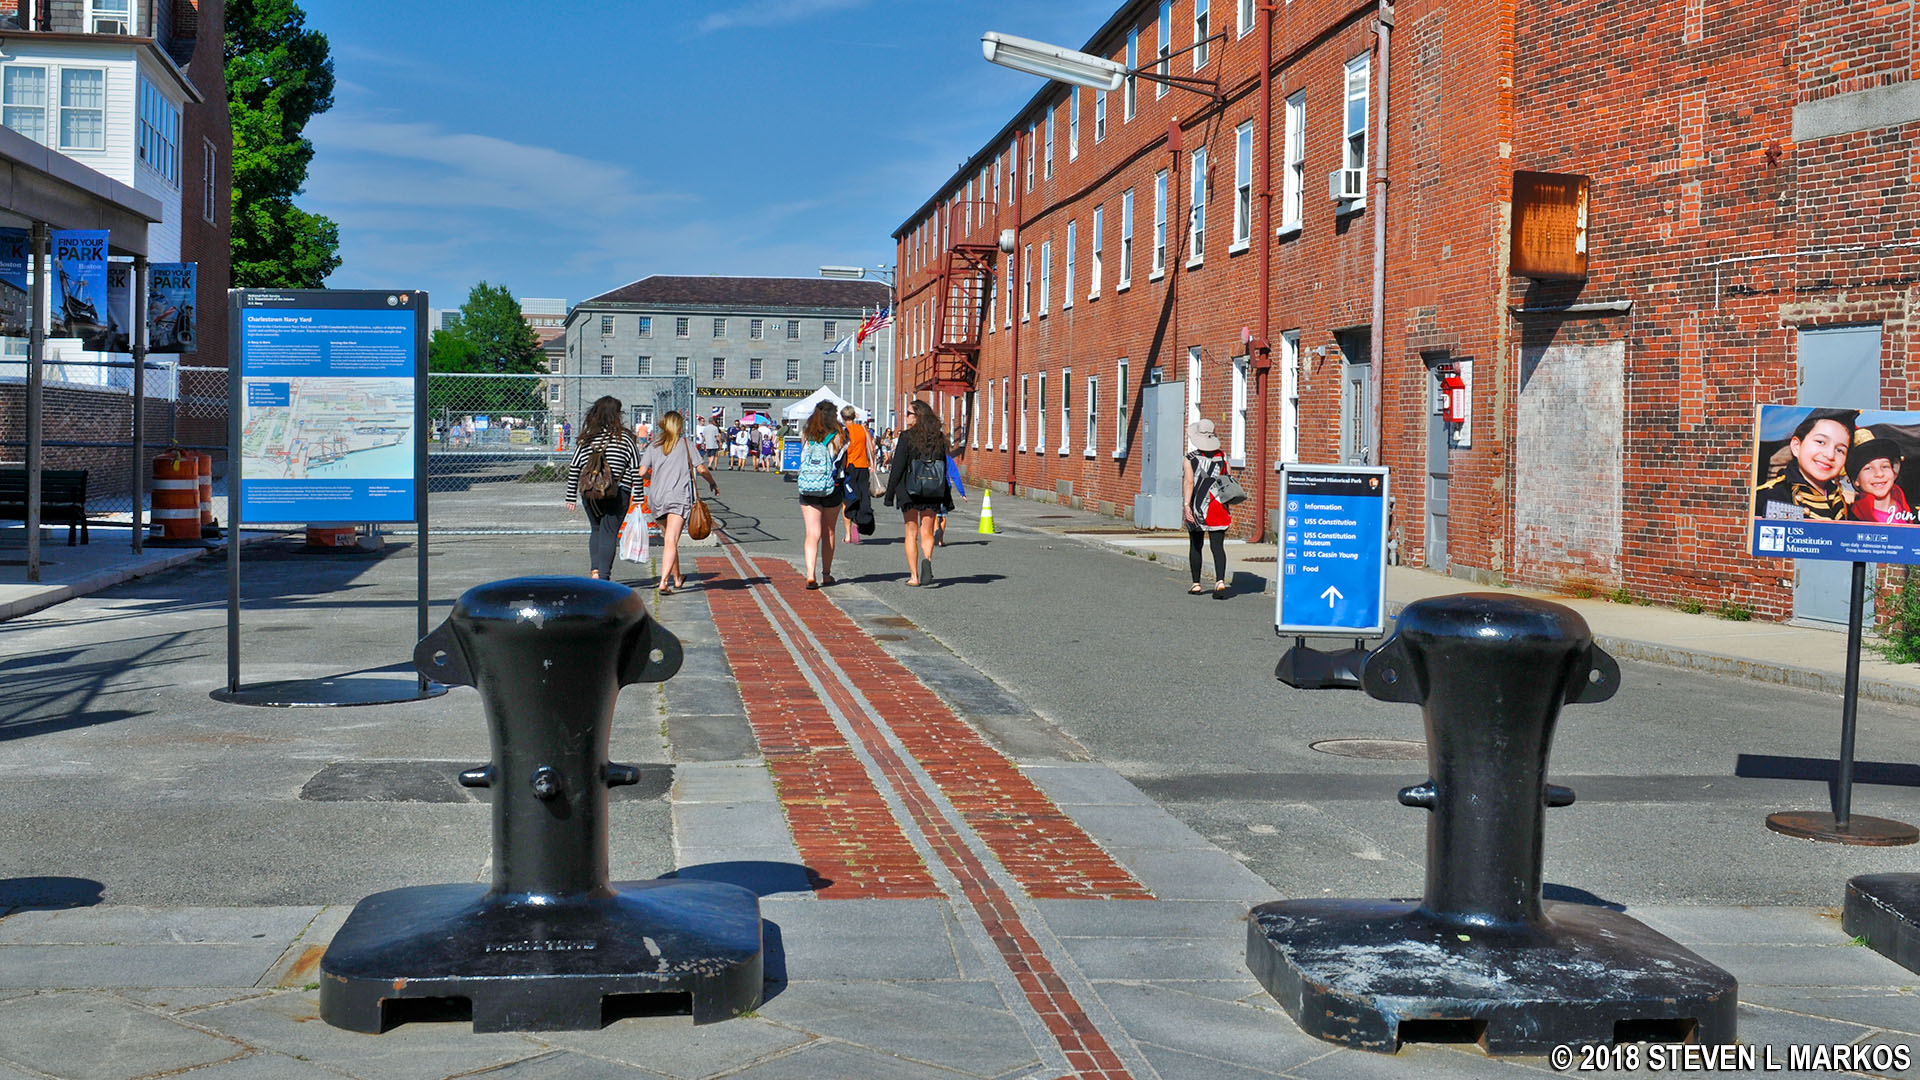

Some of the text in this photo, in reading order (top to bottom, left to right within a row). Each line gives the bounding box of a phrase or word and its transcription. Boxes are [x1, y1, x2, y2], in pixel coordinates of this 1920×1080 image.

[58, 247, 103, 261] PARK
[108, 277, 125, 288] RK
[154, 276, 191, 288] PARK
[714, 387, 776, 396] CONSTITUTION
[1304, 503, 1343, 511] Information
[1886, 505, 1916, 525] Join
[1318, 518, 1357, 526] Constitution
[1317, 532, 1357, 540] Constitution
[1787, 527, 1805, 536] USS
[1786, 536, 1833, 546] Constitution
[1786, 544, 1820, 553] Museum
[1339, 552, 1359, 560] Young
[1302, 565, 1319, 573] Food
